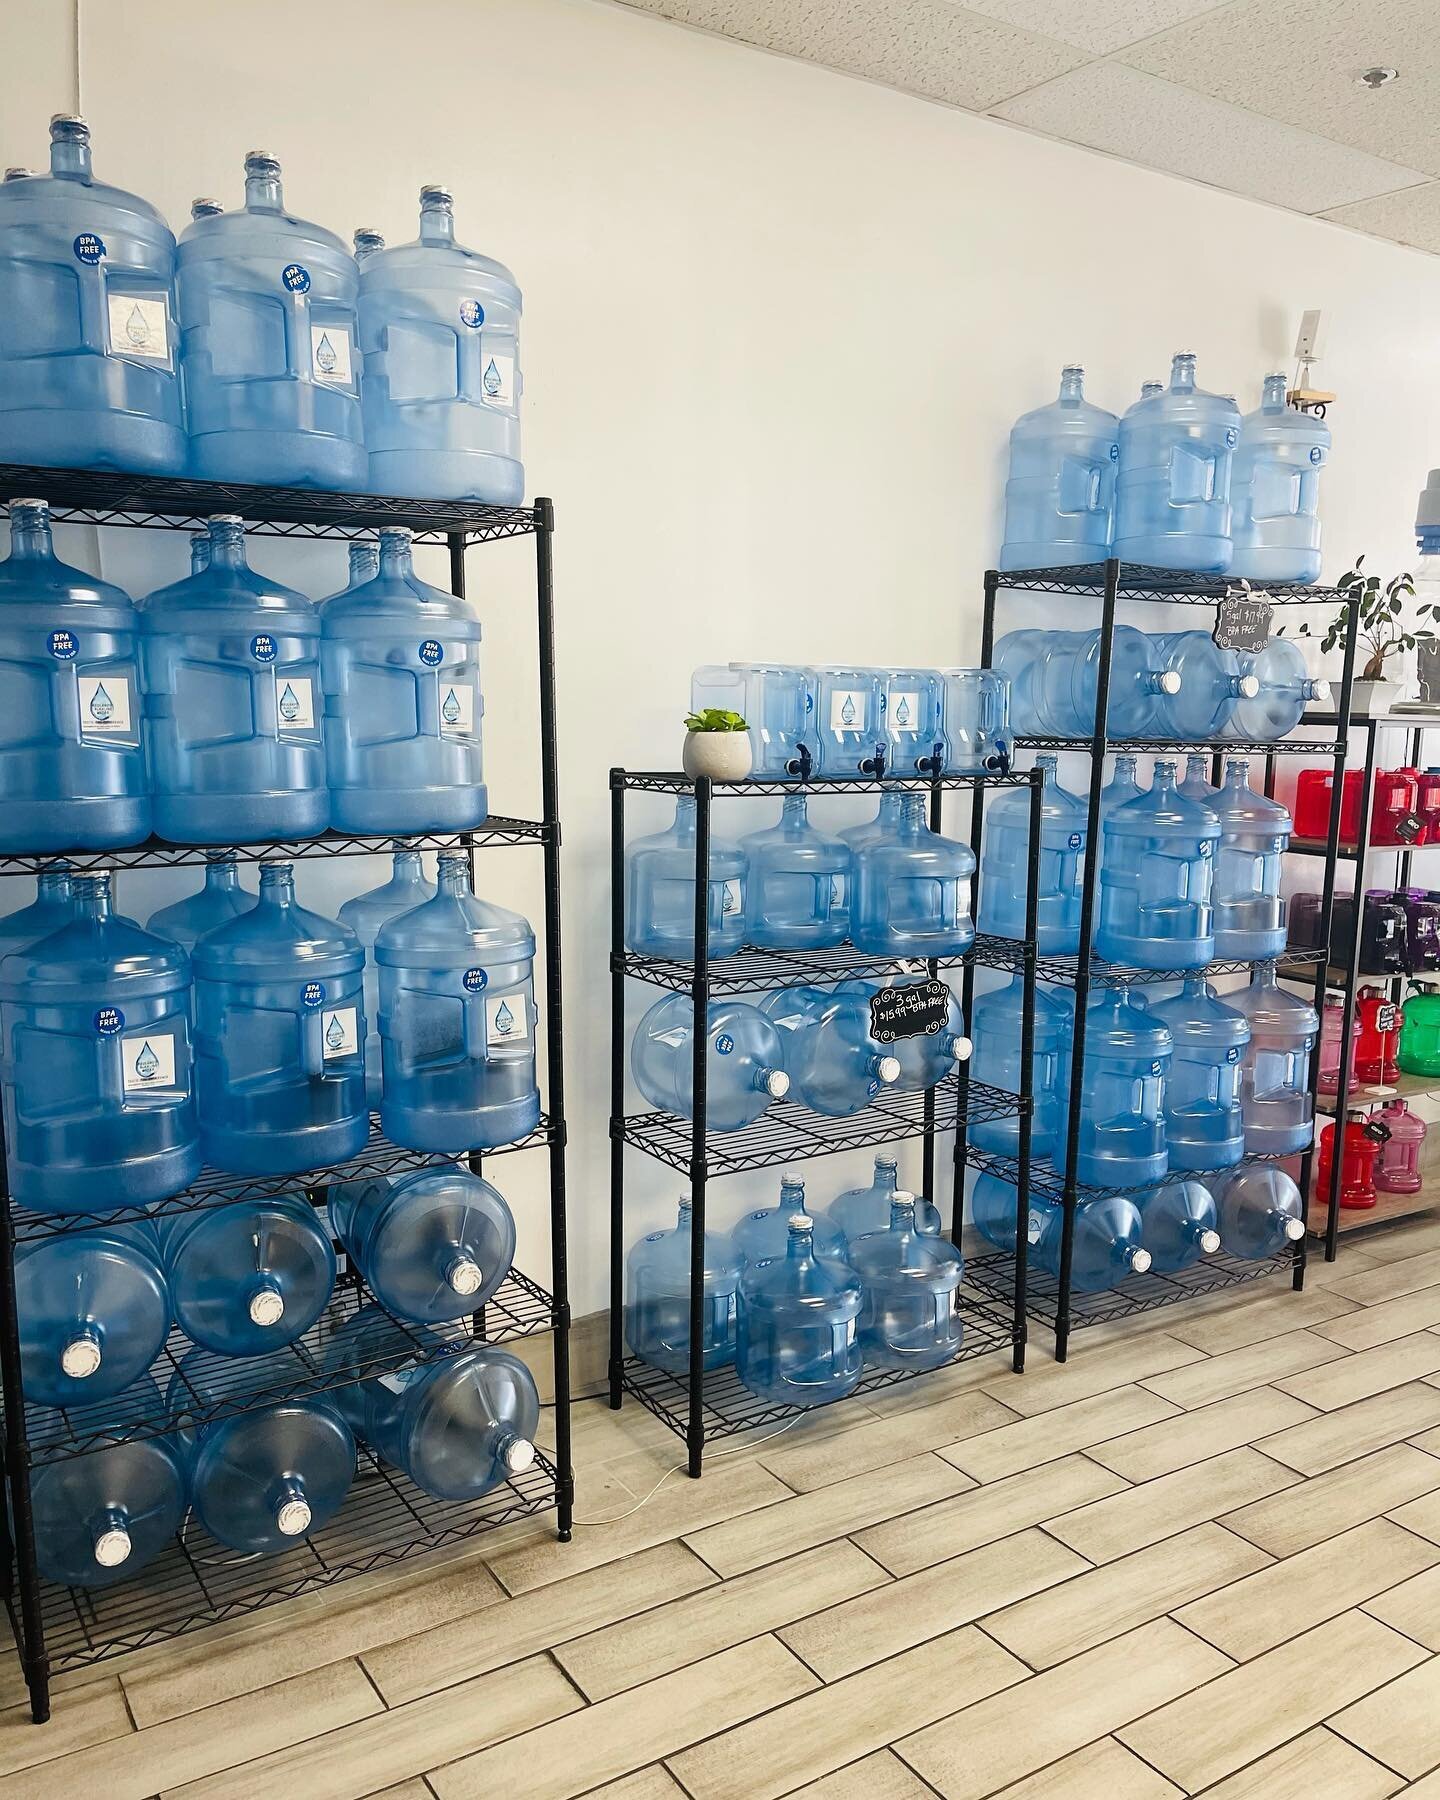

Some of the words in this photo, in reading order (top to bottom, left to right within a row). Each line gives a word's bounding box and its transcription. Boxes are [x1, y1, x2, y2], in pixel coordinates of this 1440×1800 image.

[80, 236, 96, 245] BPA
[80, 245, 100, 254] FREE
[285, 266, 299, 279] BPA
[288, 273, 305, 288] FREE
[465, 310, 481, 319] FREE
[53, 632, 70, 641] BPA
[256, 637, 270, 645] BPA
[53, 641, 73, 650] FREE
[256, 645, 273, 653] FREE
[425, 642, 438, 650] BPA
[423, 649, 439, 658] FREE
[468, 970, 481, 978] BPA
[467, 977, 483, 985] FREE
[306, 984, 320, 992] BPA
[305, 991, 321, 1000] FREE
[896, 994, 904, 1007] 3
[905, 991, 921, 1009] gal
[100, 1009, 116, 1019] BPA
[99, 1017, 119, 1027] FREE
